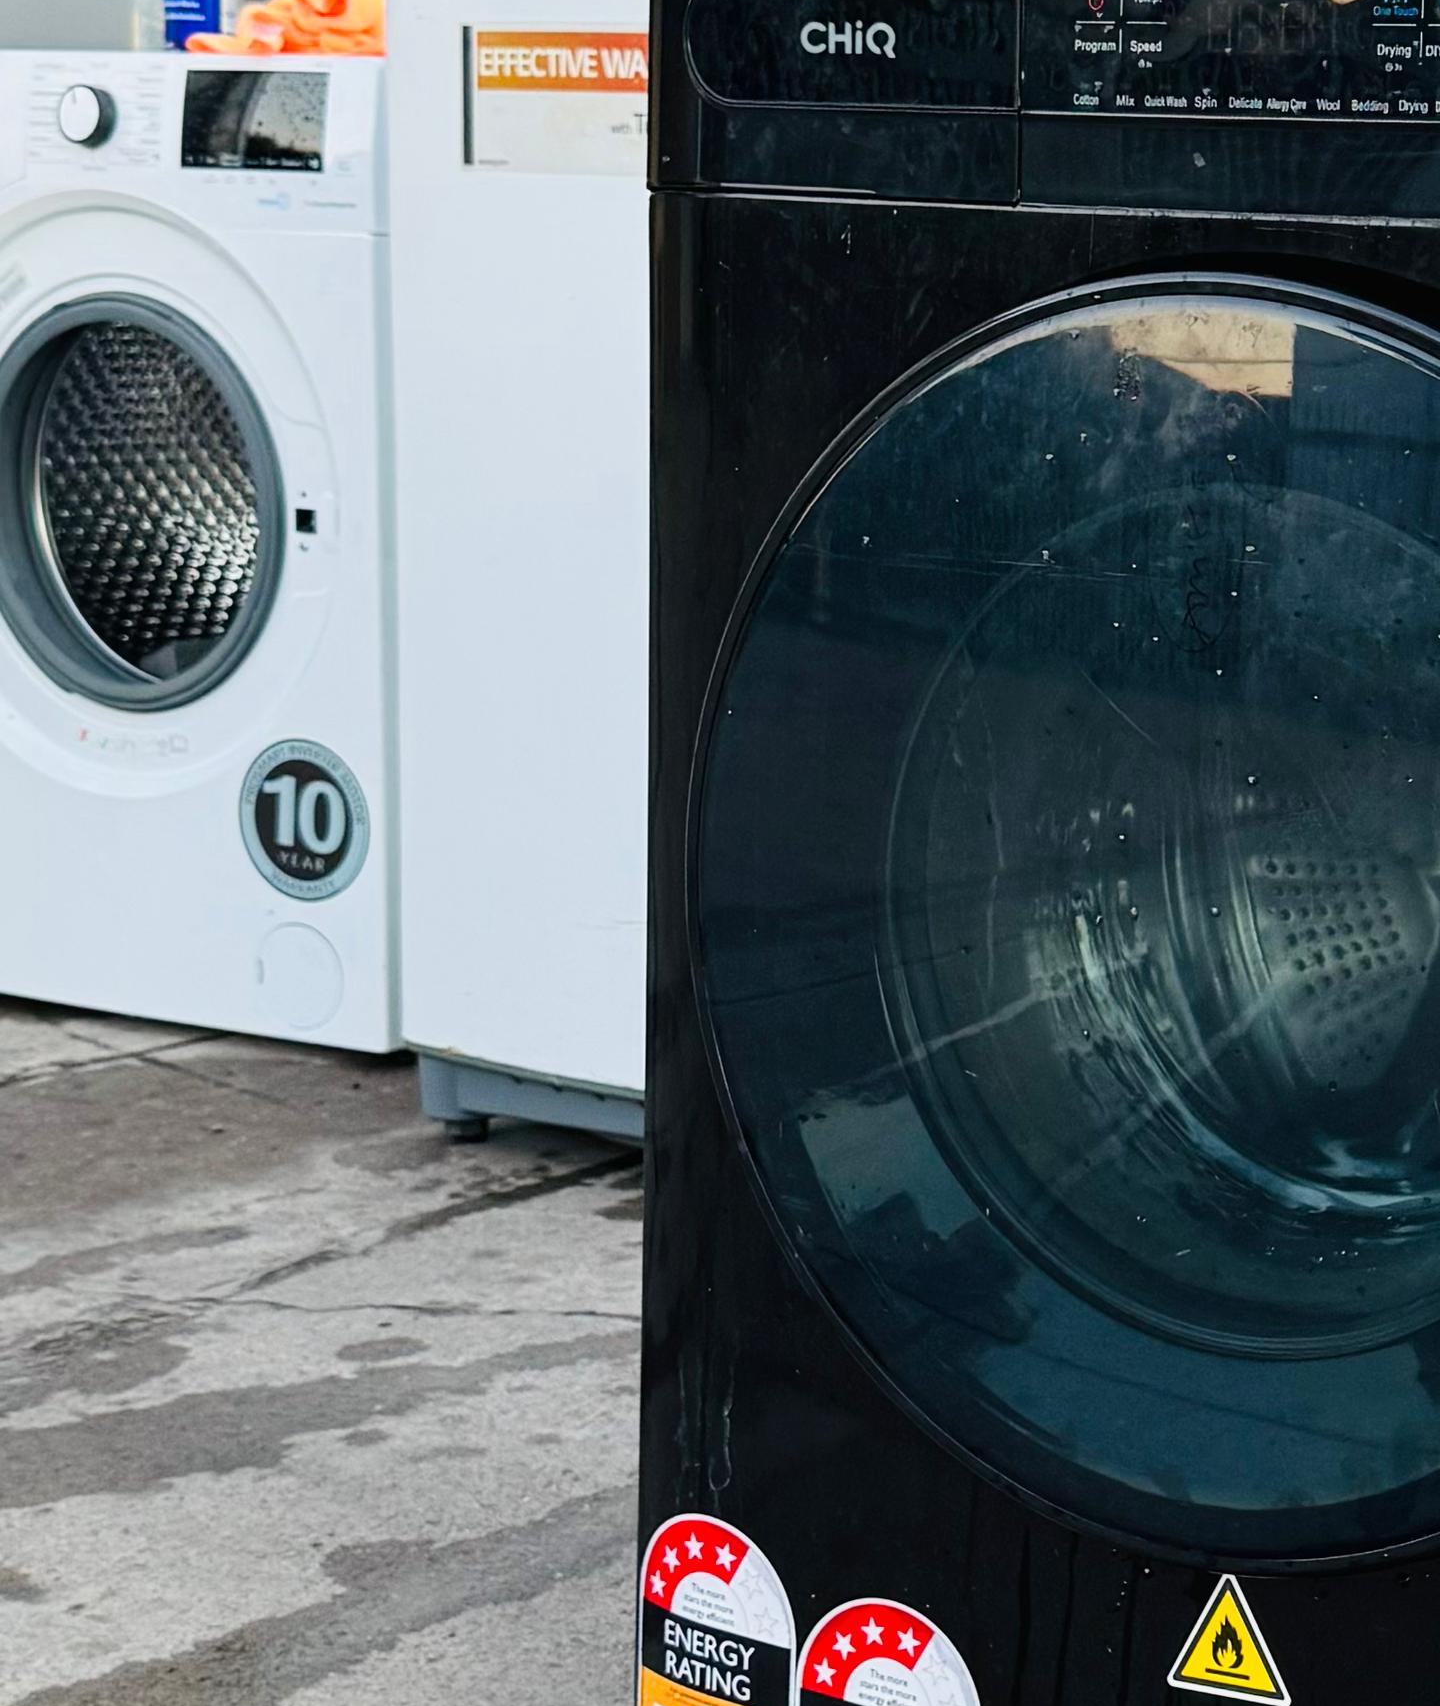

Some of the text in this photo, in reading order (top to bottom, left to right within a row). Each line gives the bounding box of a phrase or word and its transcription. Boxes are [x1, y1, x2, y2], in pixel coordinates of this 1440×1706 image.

[800, 20, 896, 59] CHiQ
[1074, 39, 1116, 54] Program
[1130, 39, 1162, 55] Speed
[1376, 43, 1412, 59] Drying
[479, 48, 648, 79] EFFECTIVE WA
[1073, 93, 1099, 106] Cotton
[1116, 94, 1135, 107] Mix
[1144, 94, 1165, 108] Quick
[1166, 95, 1187, 108] Wash
[1194, 96, 1218, 111] Spin
[1228, 96, 1263, 110] Delicate
[1316, 98, 1341, 111] Wool
[1351, 99, 1389, 114] Bedding
[1398, 99, 1429, 115] Drying
[262, 774, 347, 855] 10
[277, 851, 326, 872] YEAR
[664, 1618, 756, 1671] ENERGY
[664, 1649, 751, 1702] RATING
[870, 1668, 909, 1687] The more
[858, 1693, 885, 1706] energy
[859, 1680, 917, 1702] stars the more
